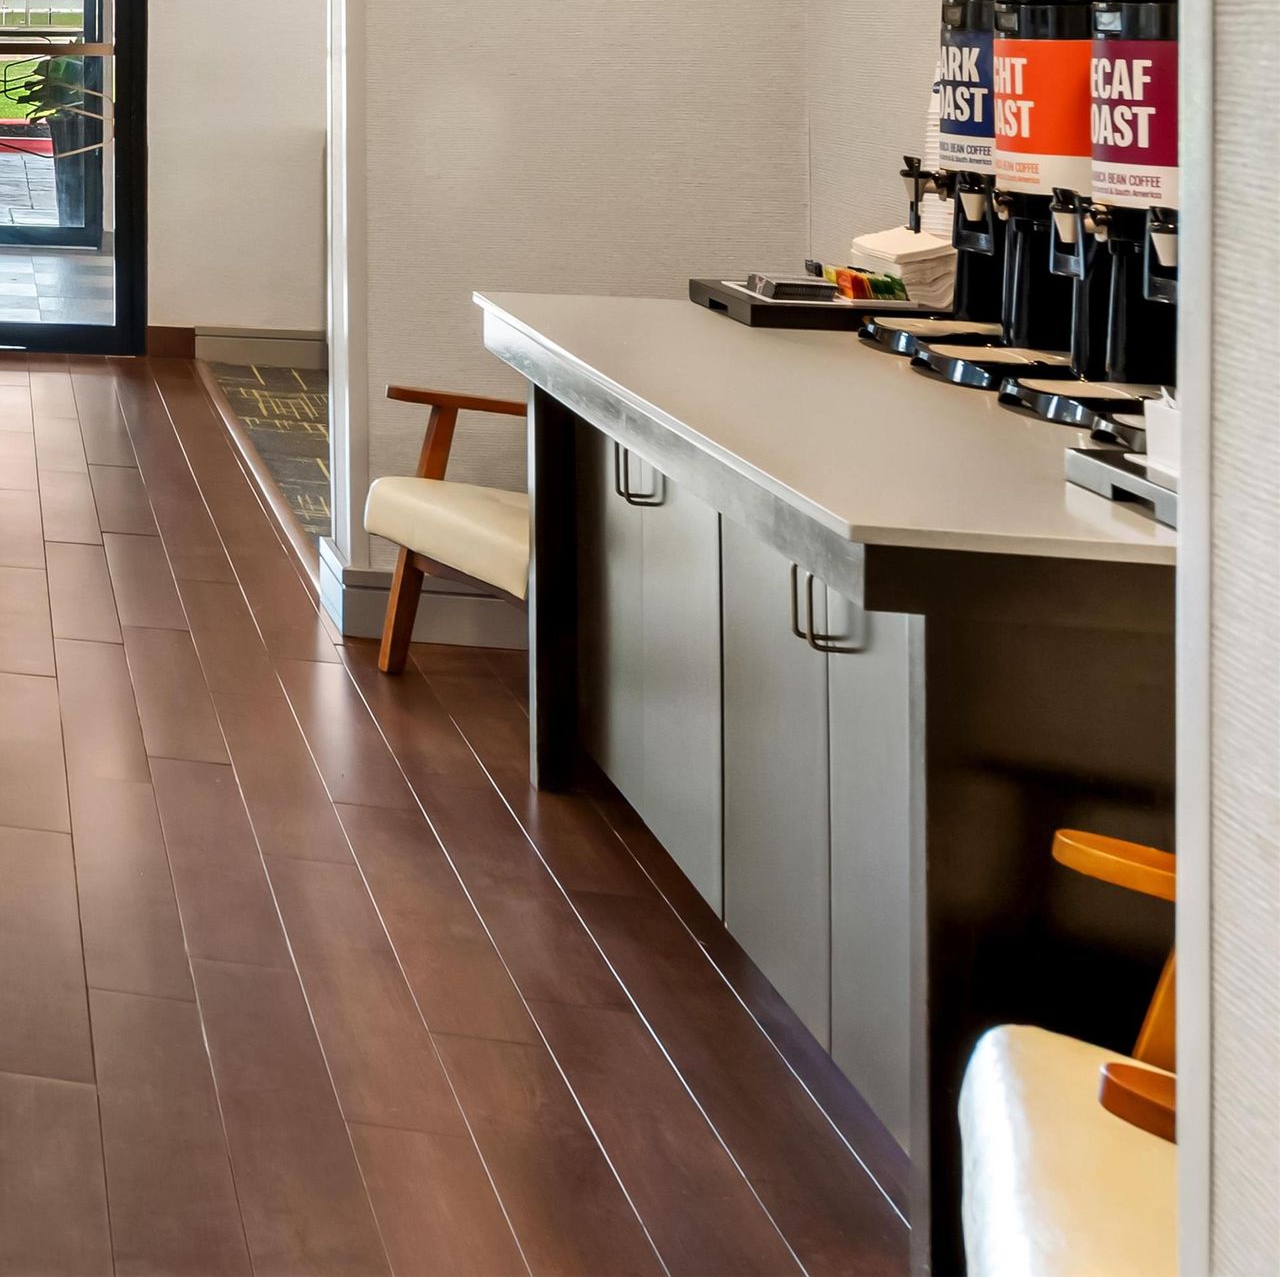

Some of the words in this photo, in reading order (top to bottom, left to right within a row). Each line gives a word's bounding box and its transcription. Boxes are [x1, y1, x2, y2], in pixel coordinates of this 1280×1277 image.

[939, 45, 981, 83] ARK
[1090, 57, 1153, 101] ECAF
[1090, 103, 1157, 149] OAST
[1129, 174, 1162, 188] COFFEE
